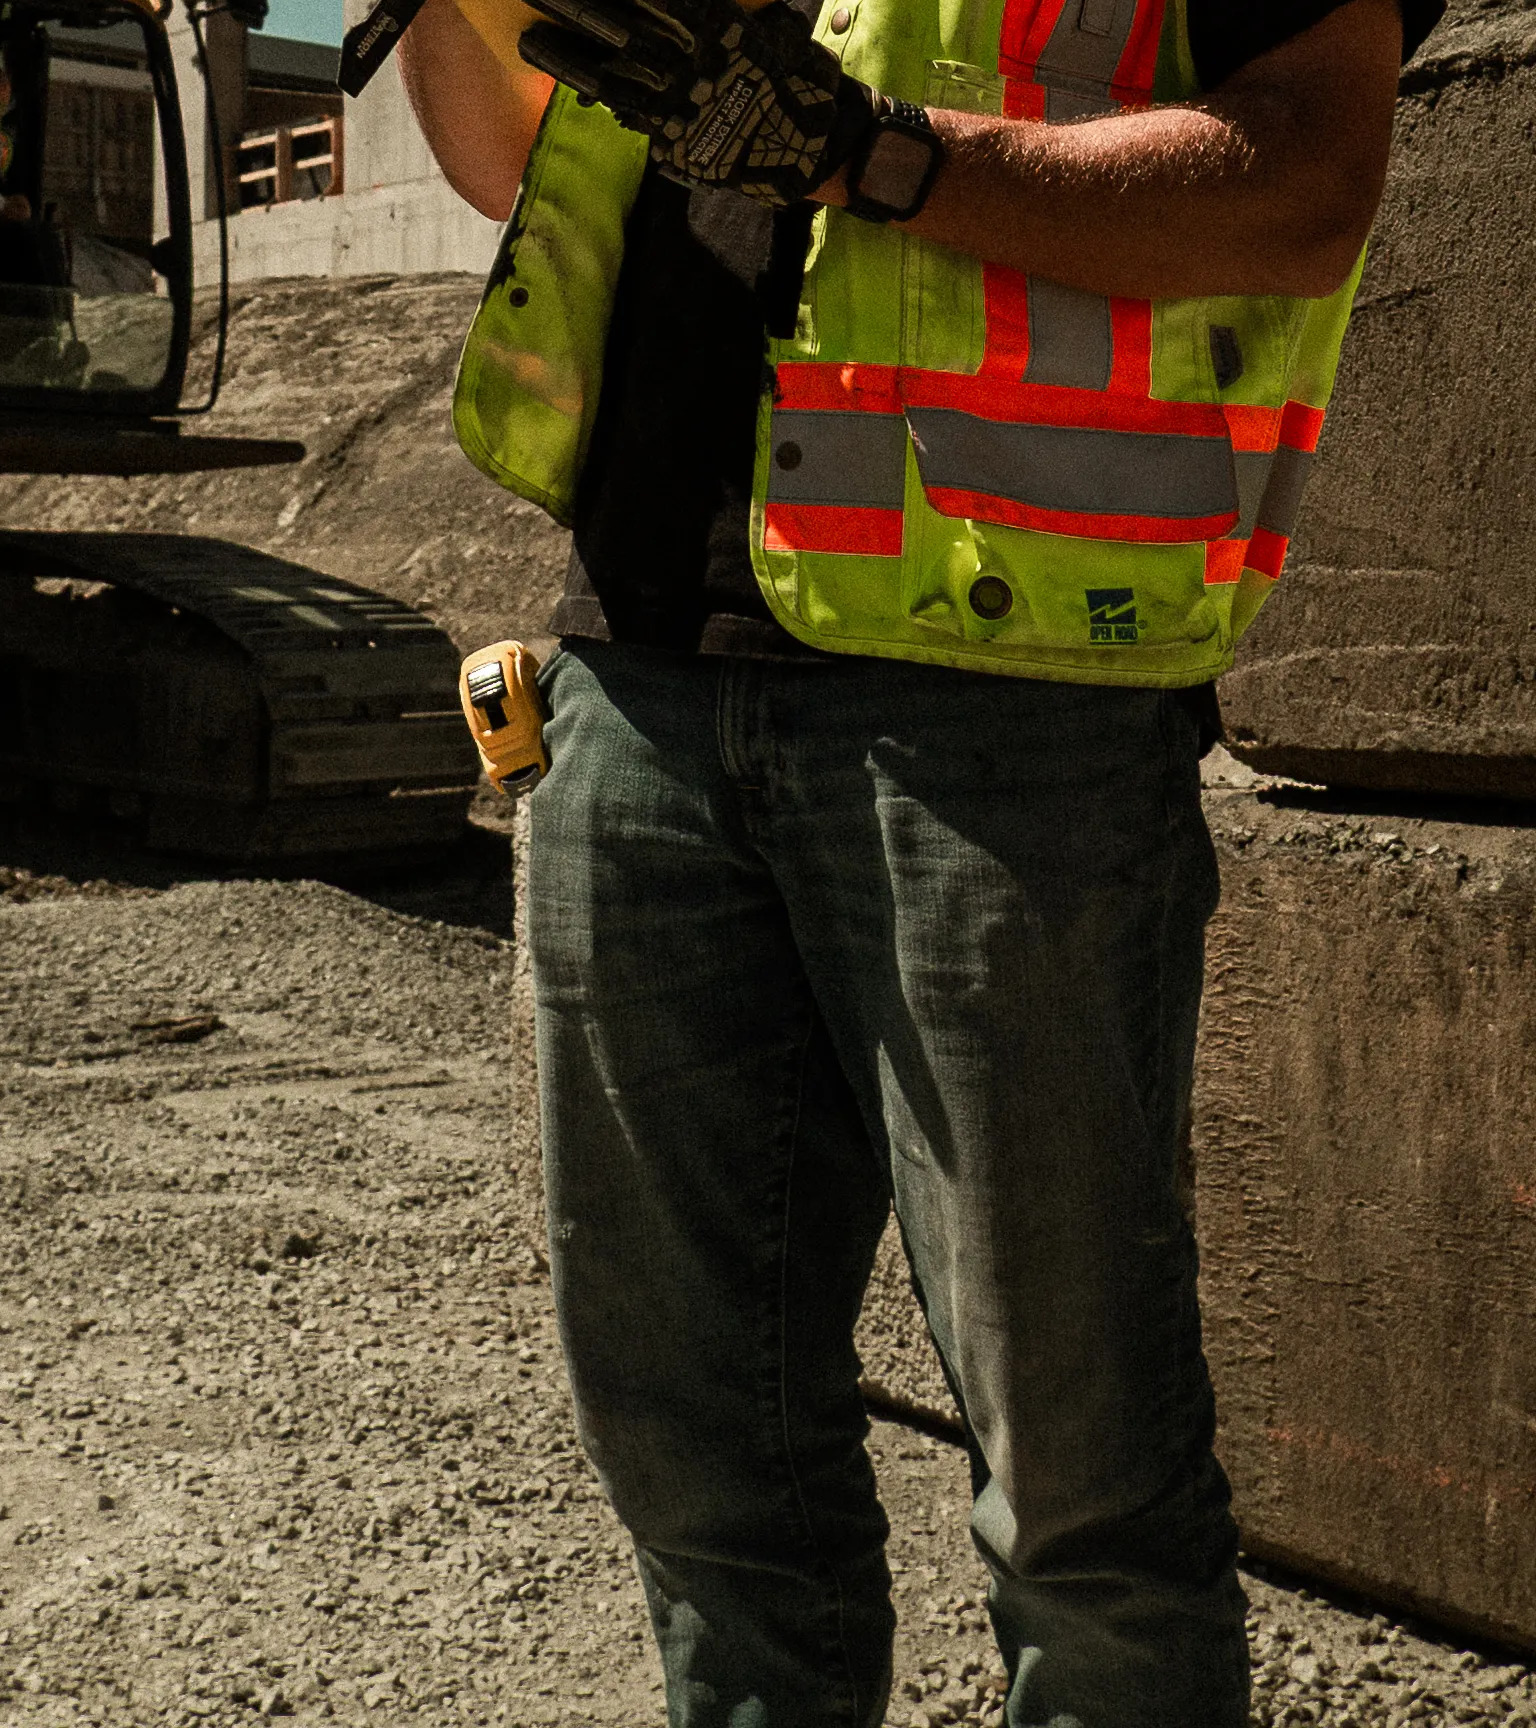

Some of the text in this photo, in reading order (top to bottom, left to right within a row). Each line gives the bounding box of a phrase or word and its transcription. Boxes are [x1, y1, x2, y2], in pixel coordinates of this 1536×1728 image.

[687, 78, 745, 162] IMPACT PROTECTION
[1090, 625, 1112, 641] OPEN
